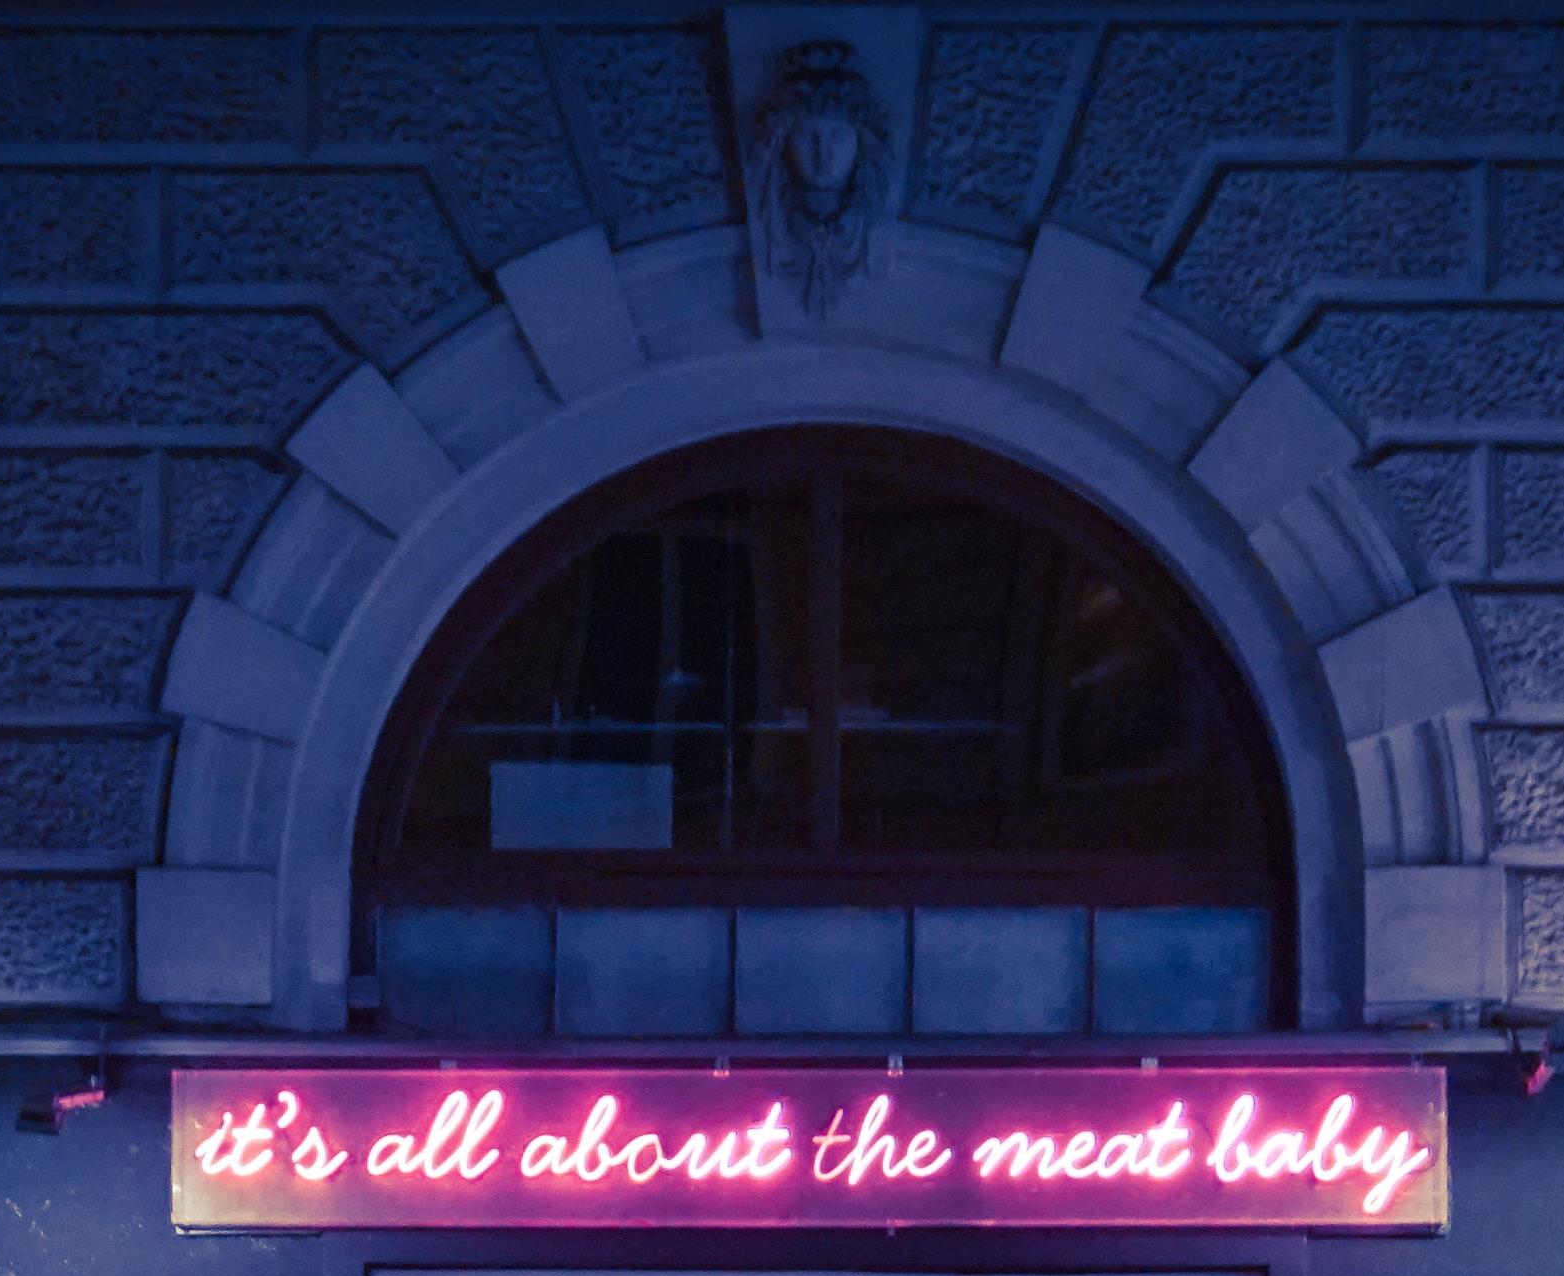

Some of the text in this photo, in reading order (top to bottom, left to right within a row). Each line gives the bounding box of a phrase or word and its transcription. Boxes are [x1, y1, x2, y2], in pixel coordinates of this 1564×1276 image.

[194, 1089, 1432, 1215] it's all about the meat baby
